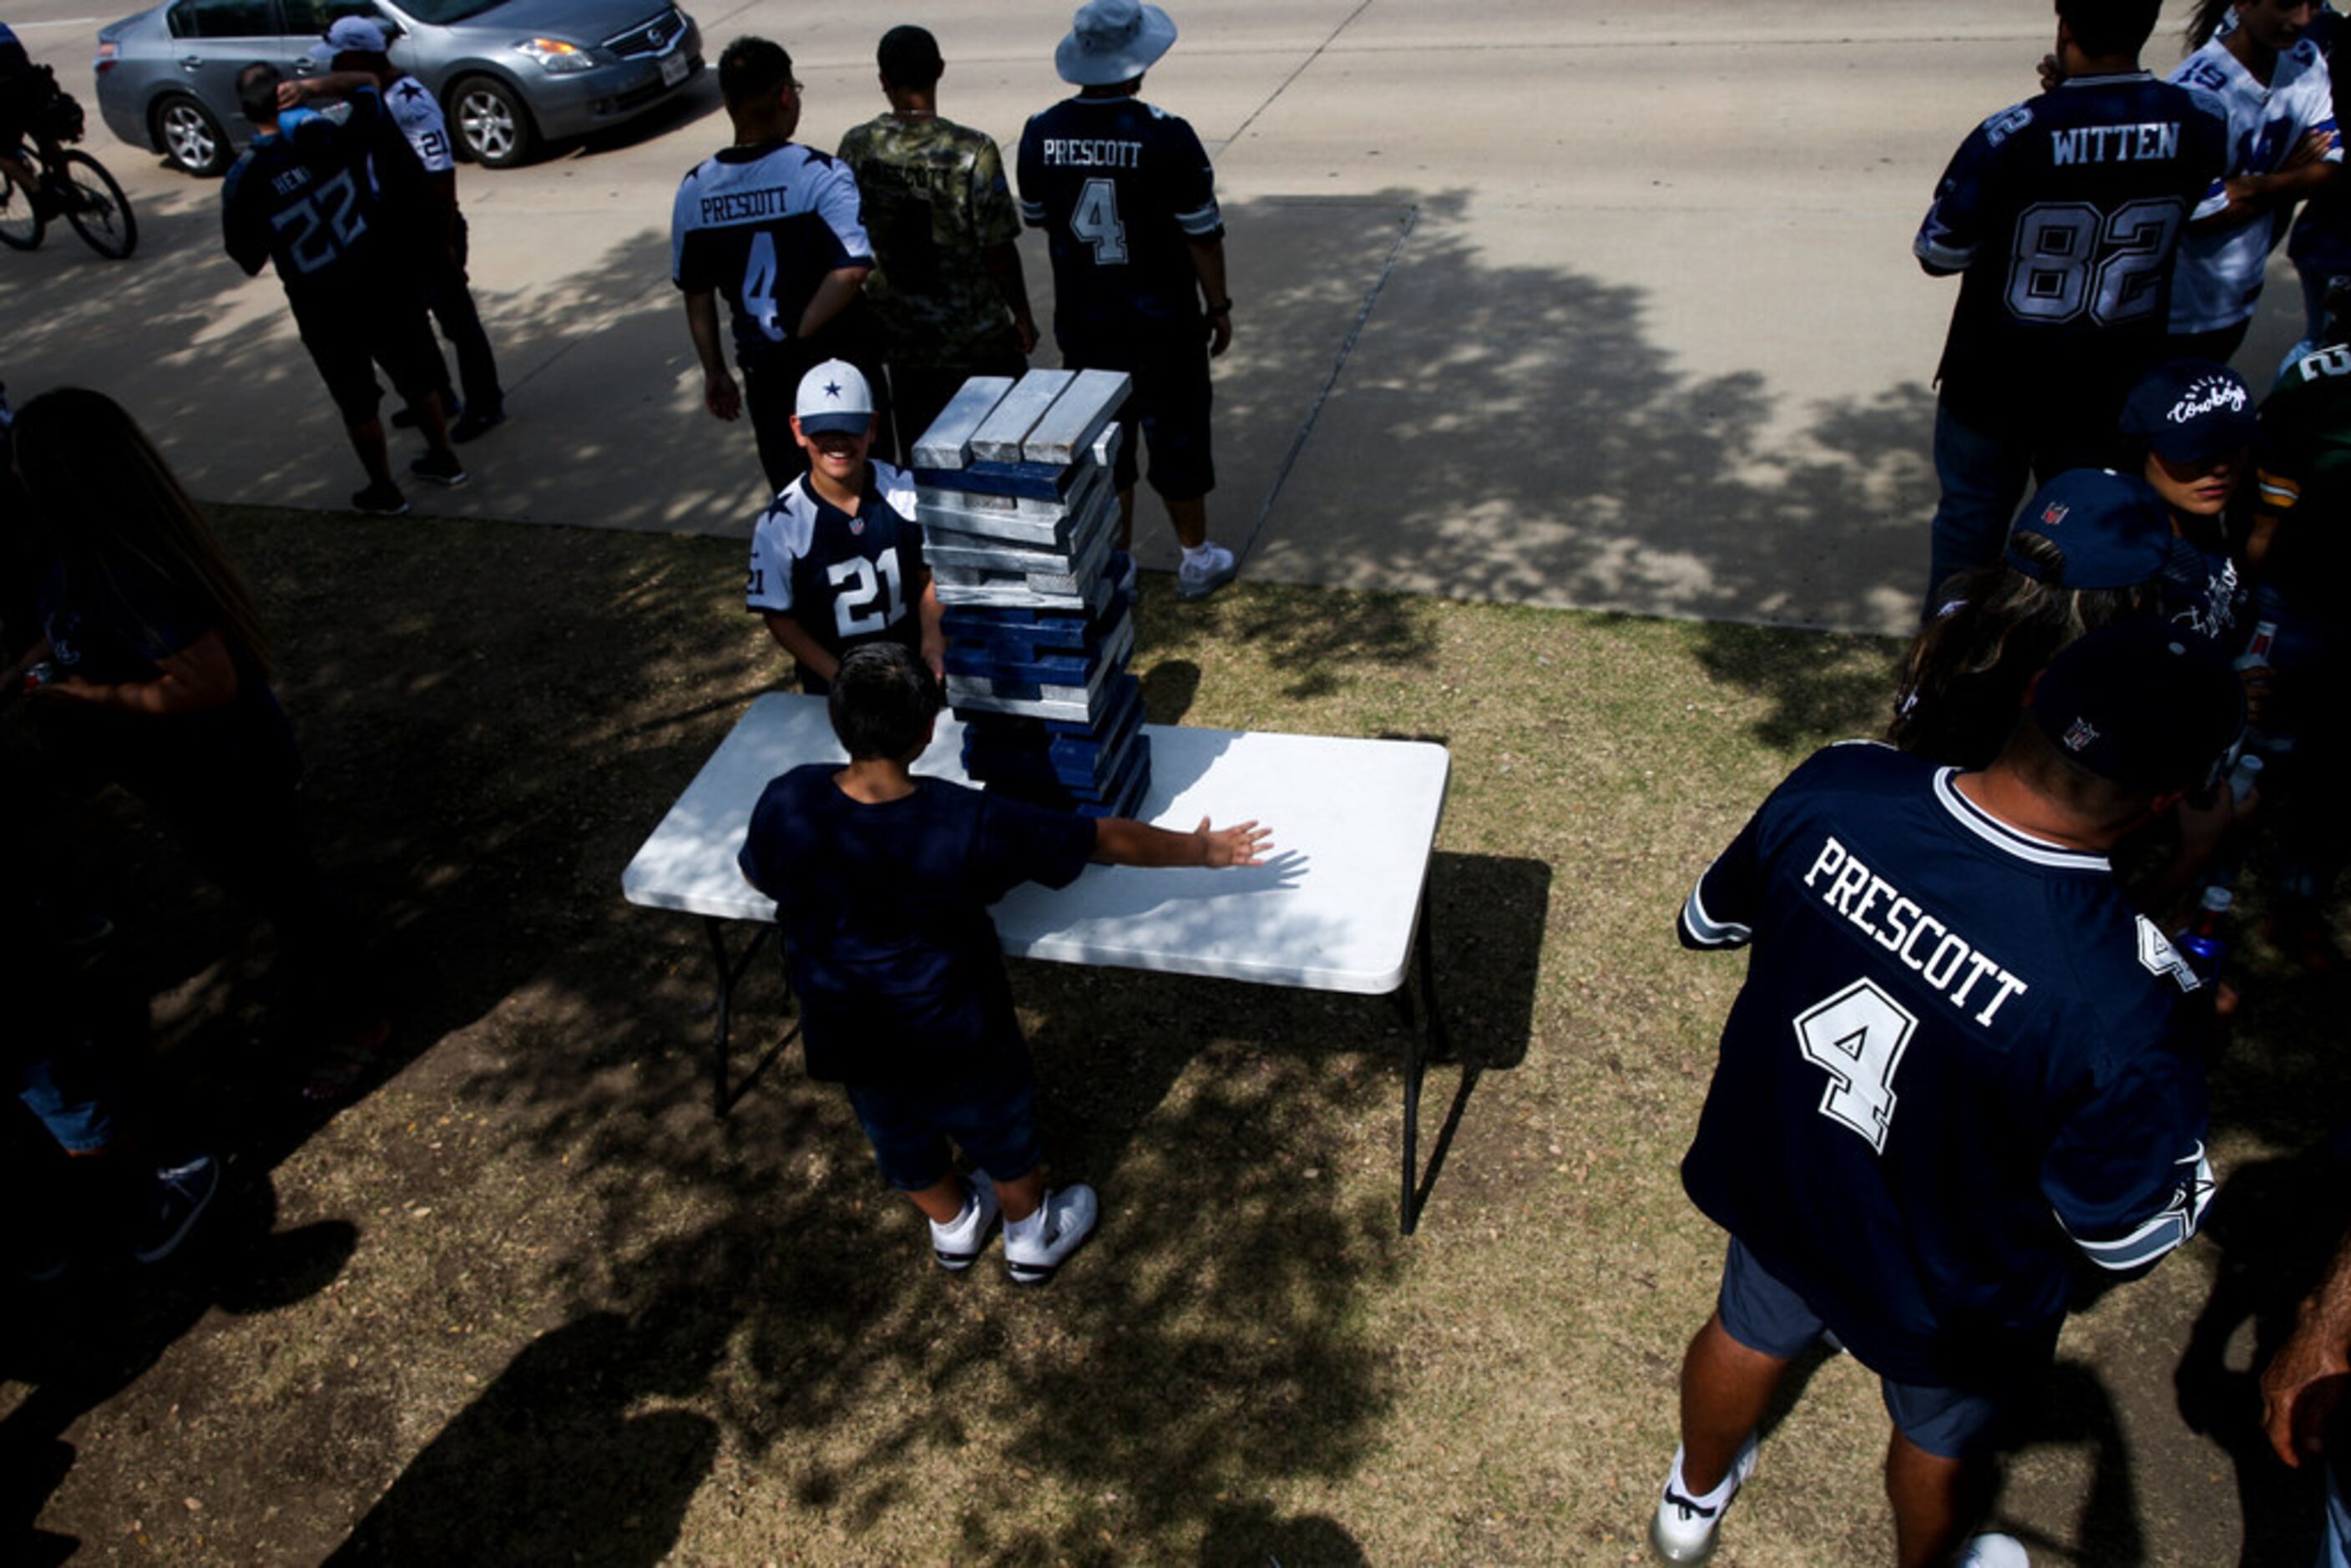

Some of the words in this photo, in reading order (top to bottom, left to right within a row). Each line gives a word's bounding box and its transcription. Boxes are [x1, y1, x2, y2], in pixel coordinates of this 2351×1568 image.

[421, 129, 448, 157] 21
[1043, 138, 1143, 169] PRESCOTT
[2049, 121, 2182, 167] WITTEN
[268, 164, 370, 276] 22
[700, 185, 788, 224] PRESCOTT
[1069, 177, 1130, 266] 4
[741, 230, 787, 343] 4
[2005, 194, 2188, 328] 82
[825, 544, 908, 640] 21
[1802, 834, 2030, 1029] PRESCOTT
[2134, 912, 2202, 994] 4
[1792, 975, 1920, 1157] 4
